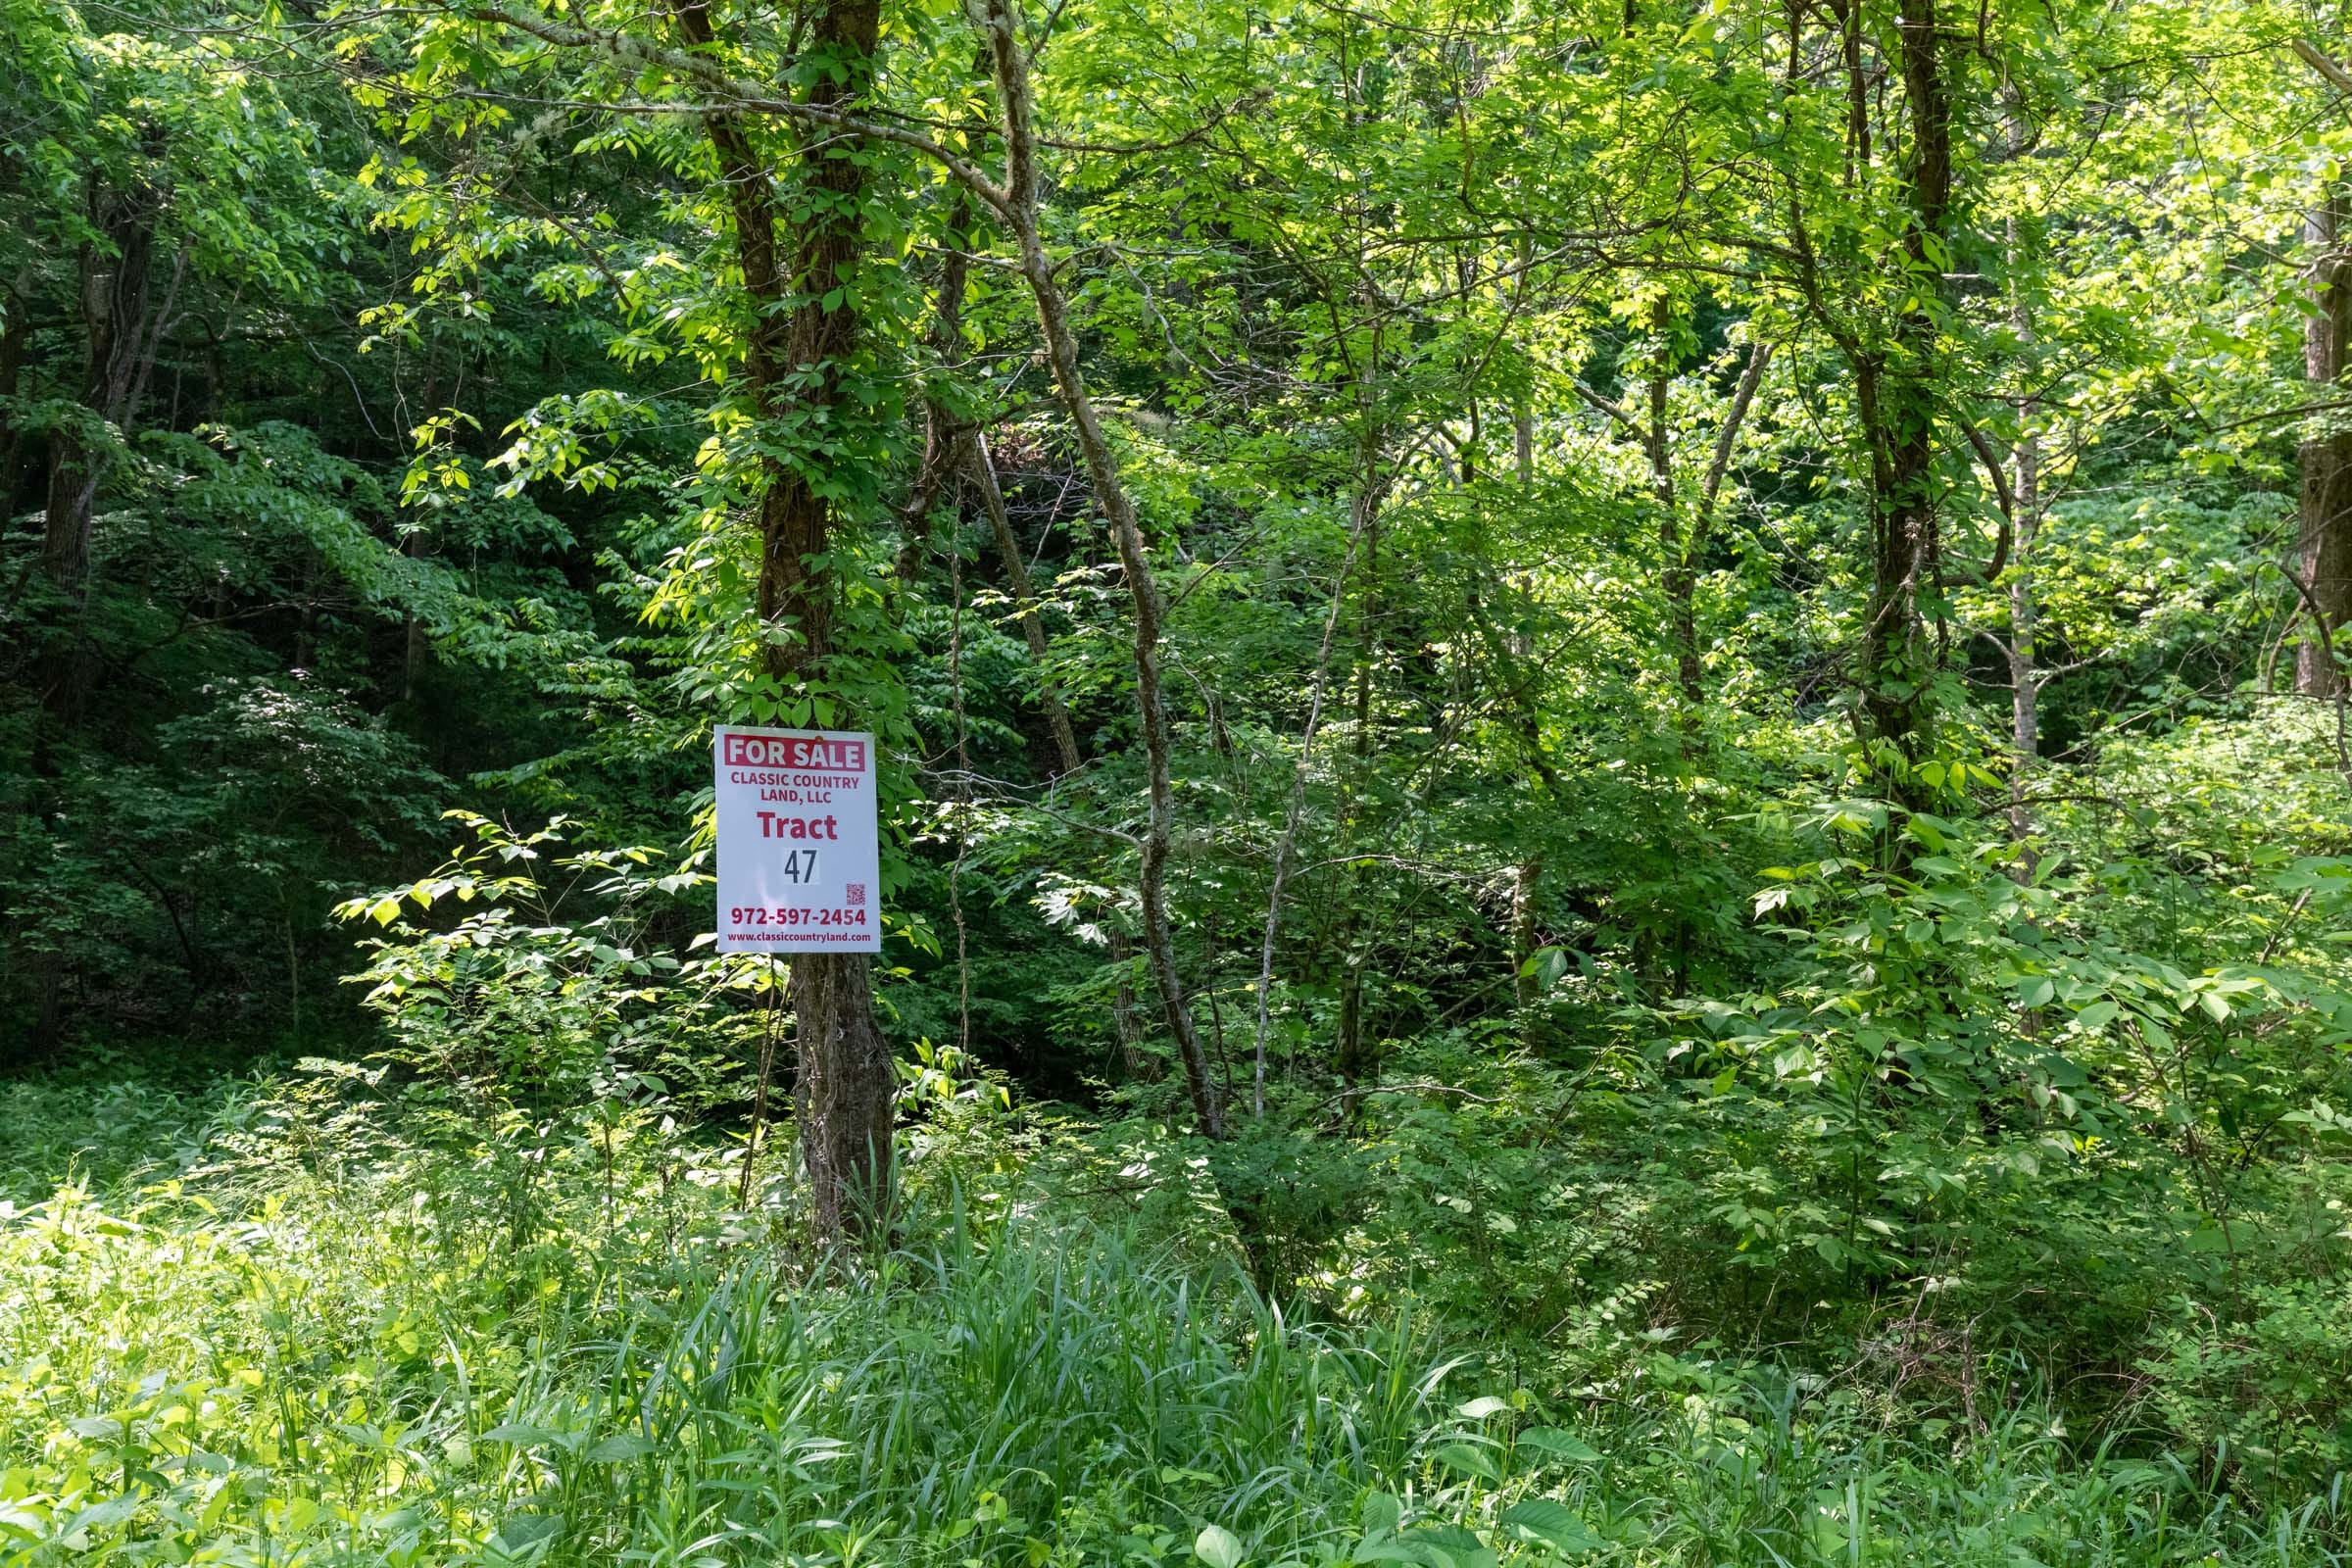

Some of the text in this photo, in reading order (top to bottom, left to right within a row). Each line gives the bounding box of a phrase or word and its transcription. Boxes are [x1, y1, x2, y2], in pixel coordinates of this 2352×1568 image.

[729, 739, 860, 769] FOR SALE
[730, 771, 859, 789] CLASSIC COUNTRY
[760, 789, 832, 806] LAND, LLC
[757, 811, 838, 840] Tract
[784, 850, 817, 883] 47
[731, 907, 866, 925] 972-597-2454
[727, 932, 871, 944] www.classiccountryland.com
